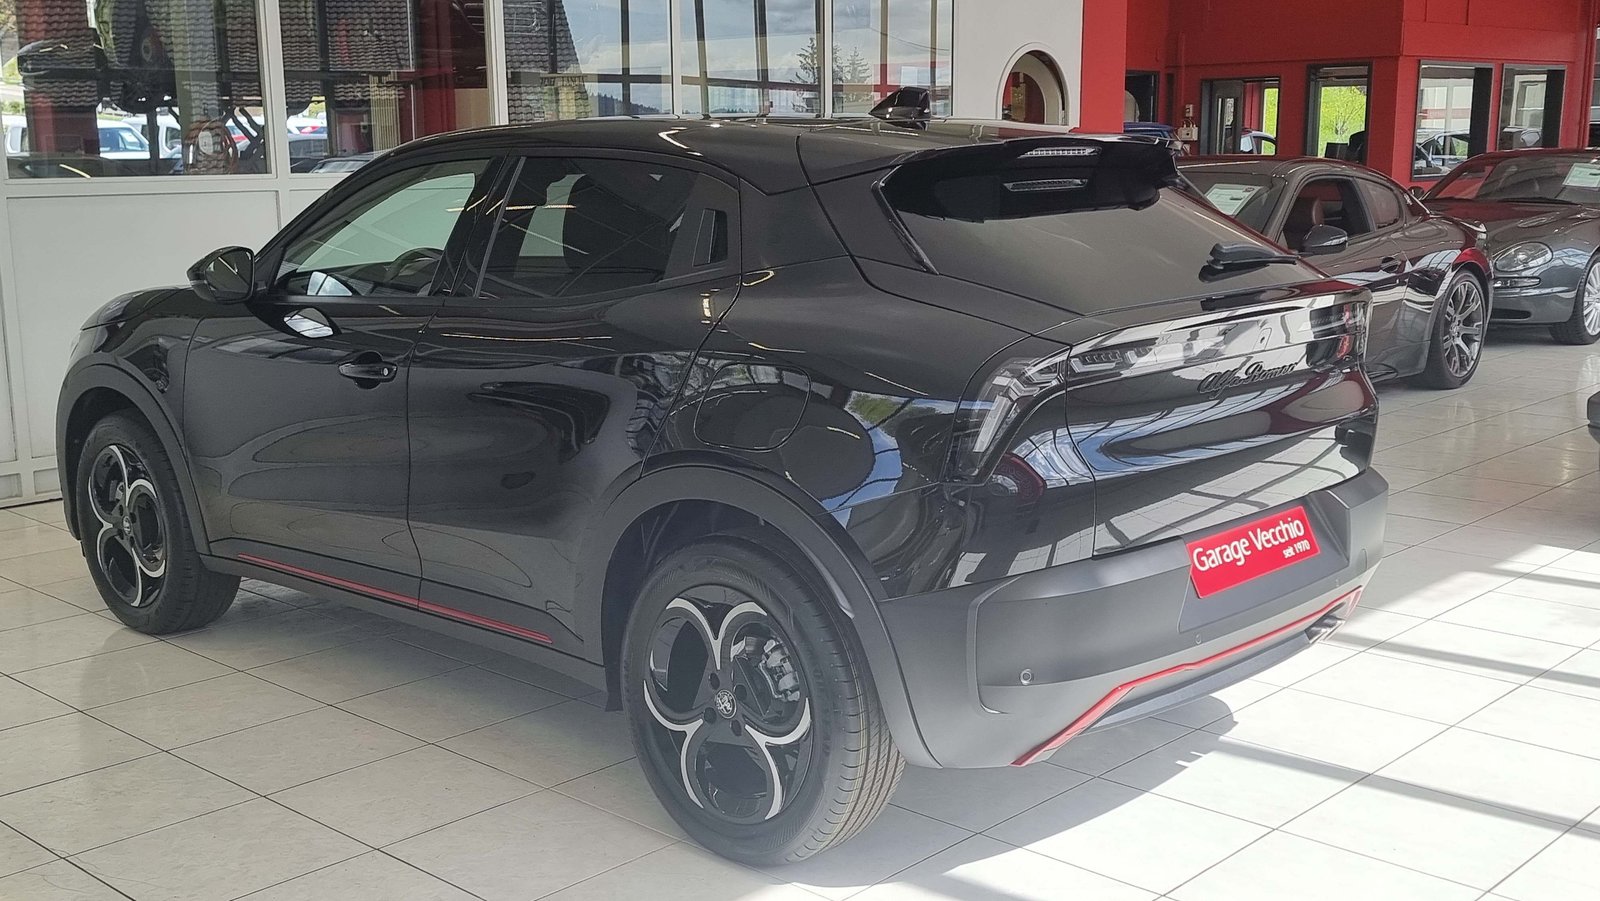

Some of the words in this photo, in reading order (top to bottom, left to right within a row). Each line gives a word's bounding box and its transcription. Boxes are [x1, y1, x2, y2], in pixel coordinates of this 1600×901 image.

[1197, 368, 1242, 400] Alfa
[1243, 361, 1299, 385] Romeo
[1192, 538, 1251, 571] Garage
[1248, 517, 1305, 551] Vecchio
[1282, 545, 1296, 558] seit
[1293, 539, 1311, 554] 1970
